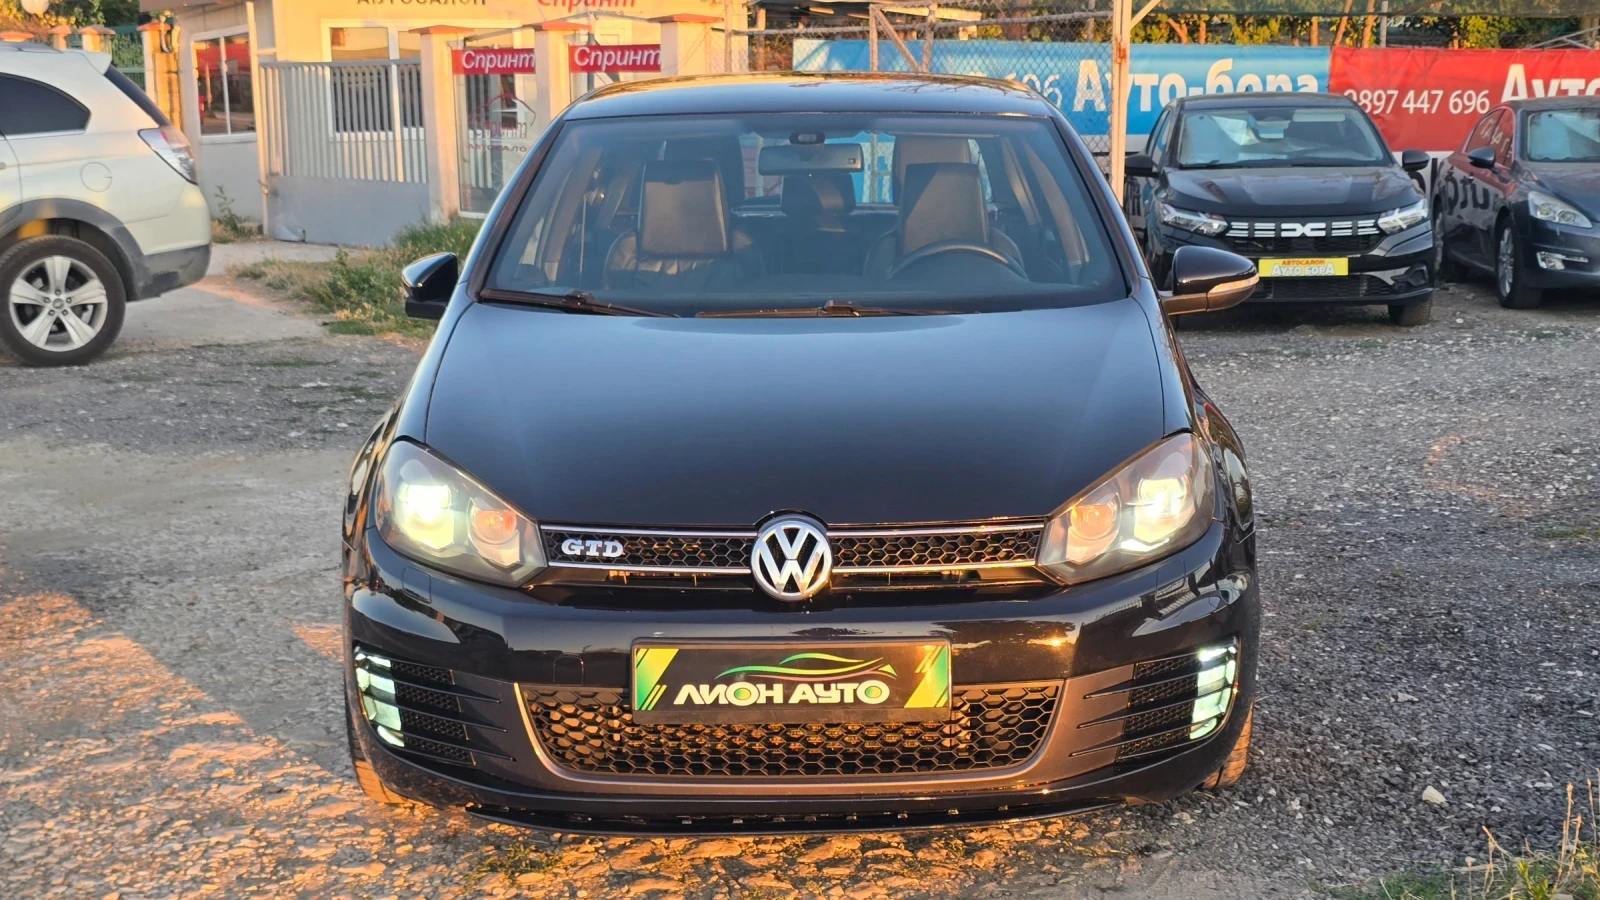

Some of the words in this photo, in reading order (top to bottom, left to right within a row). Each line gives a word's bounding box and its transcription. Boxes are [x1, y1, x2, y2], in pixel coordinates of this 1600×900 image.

[462, 50, 536, 74] Спринт
[574, 46, 661, 71] Спринт
[1402, 89, 1444, 114] 447
[1449, 89, 1490, 114] 696
[561, 538, 624, 558] GTD
[673, 681, 784, 706] ЛИОН
[788, 680, 890, 704] АУТО
